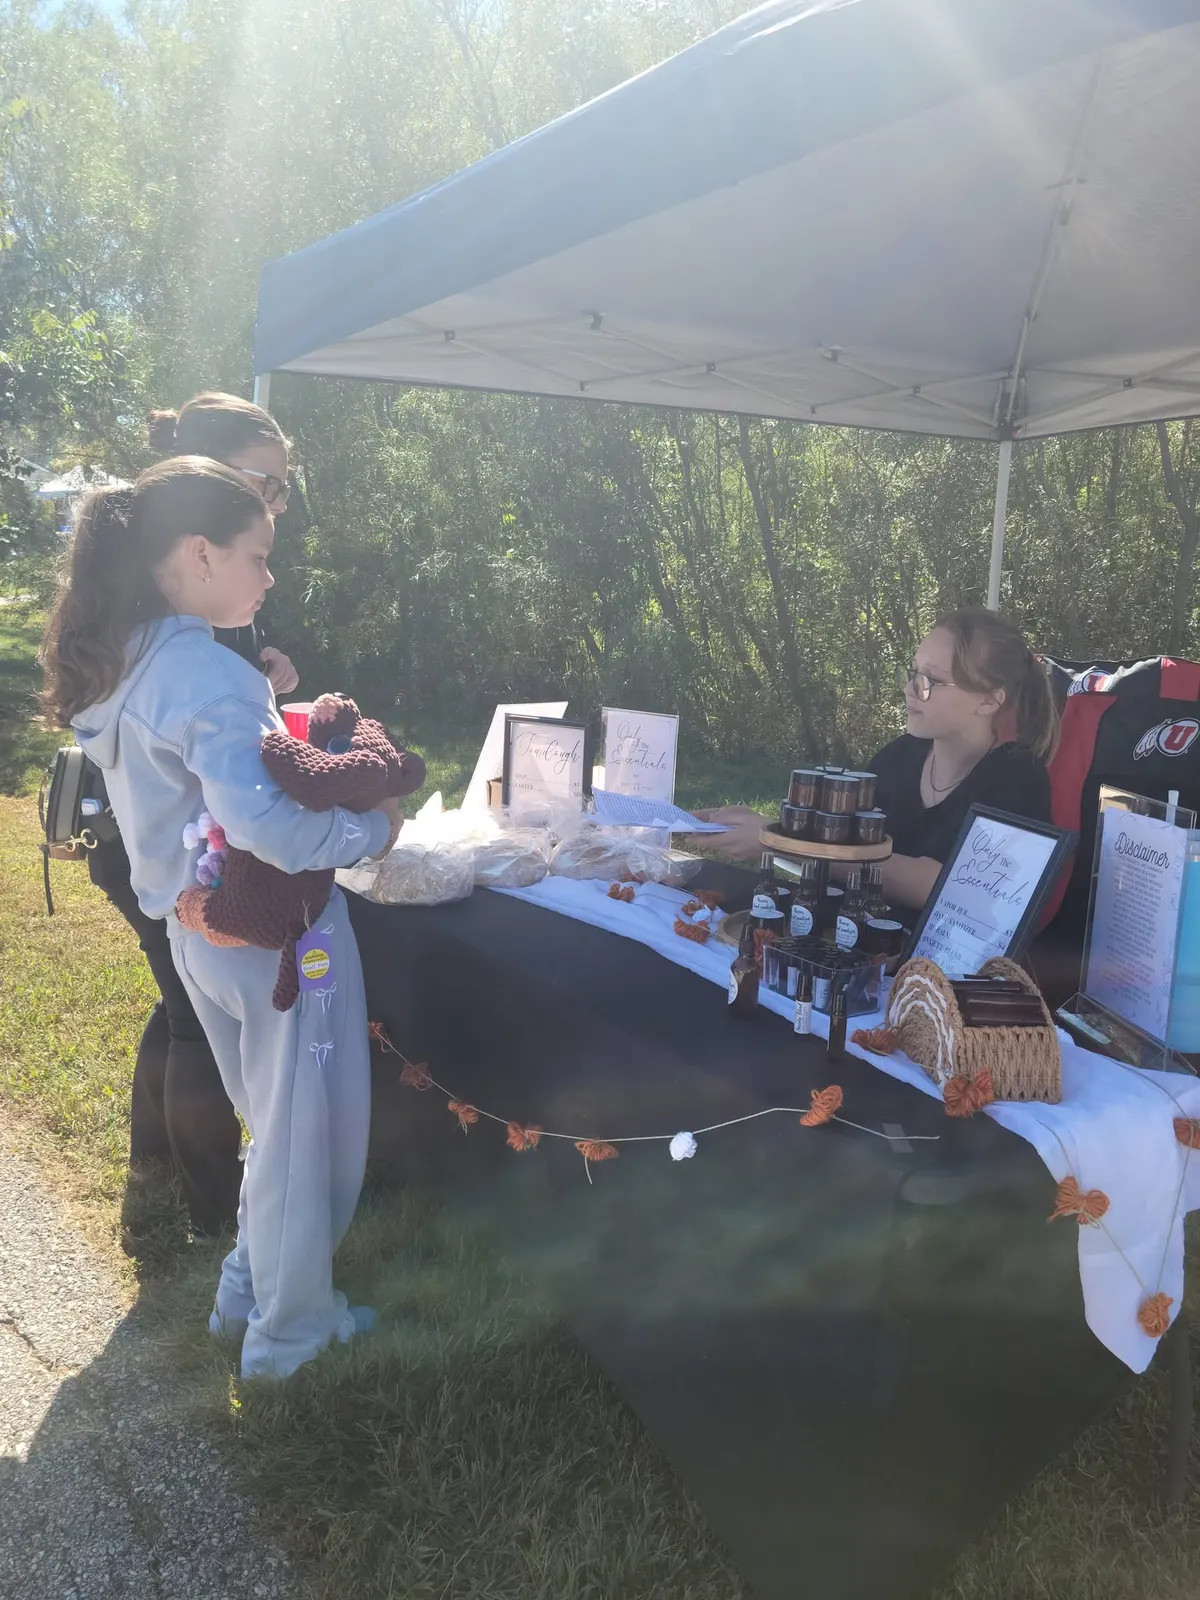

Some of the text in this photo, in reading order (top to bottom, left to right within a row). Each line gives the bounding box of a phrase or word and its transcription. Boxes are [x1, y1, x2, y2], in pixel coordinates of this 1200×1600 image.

[617, 719, 642, 753] Only
[1163, 724, 1198, 752] U
[971, 827, 1007, 872] Only
[1114, 831, 1170, 869] Disclaimer
[951, 858, 1029, 906] Essentials
